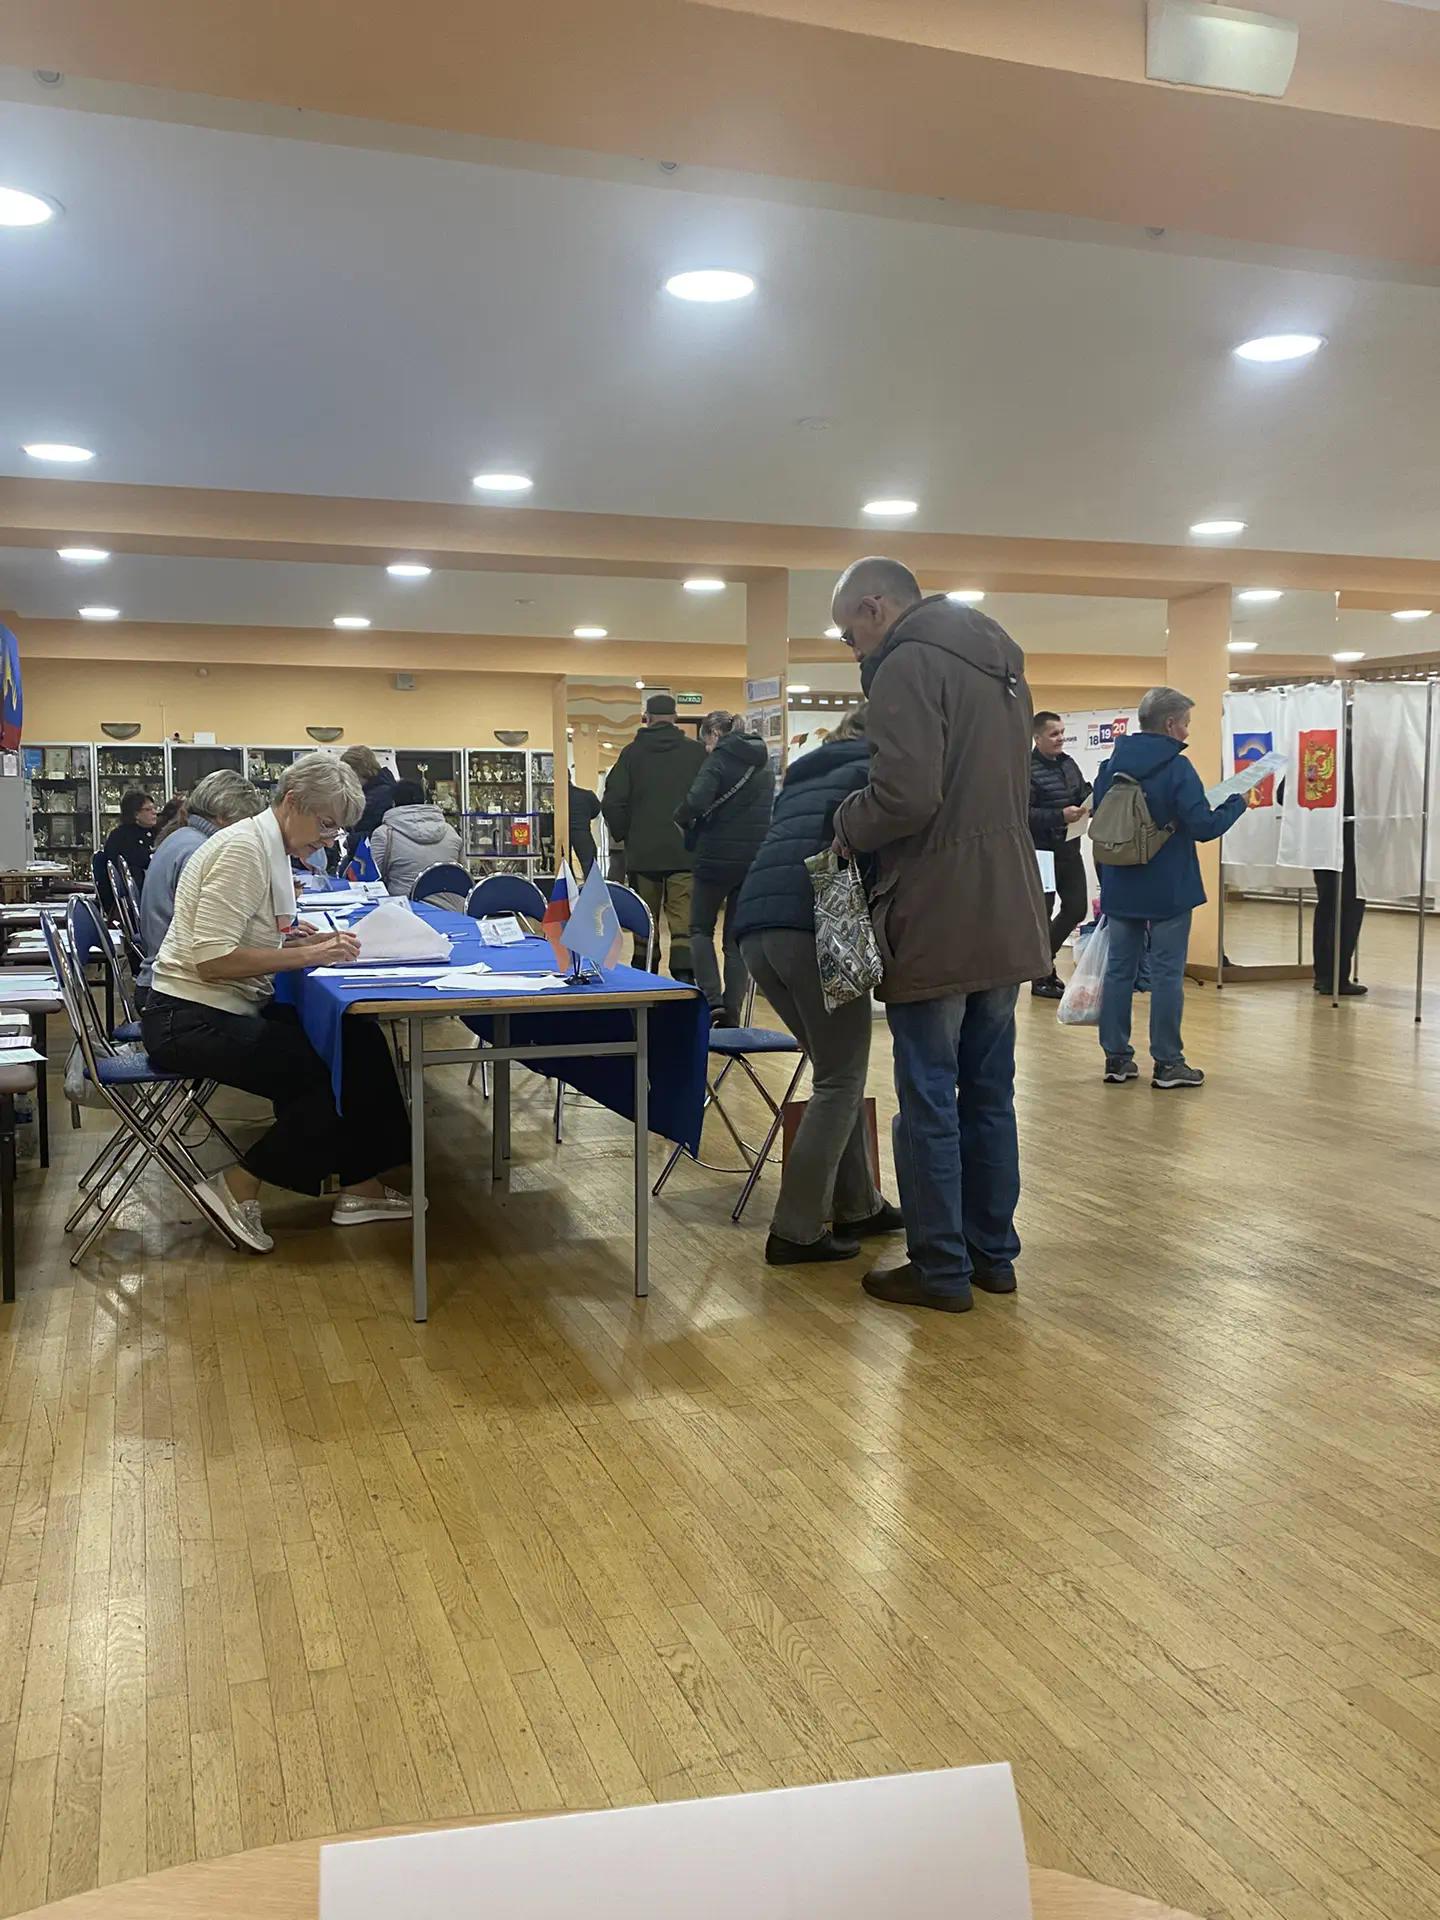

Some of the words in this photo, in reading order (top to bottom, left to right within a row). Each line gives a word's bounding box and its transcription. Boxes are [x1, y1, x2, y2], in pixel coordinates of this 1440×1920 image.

[1088, 735, 1099, 746] 18
[1101, 728, 1112, 740] 19
[1113, 722, 1126, 734] 20
